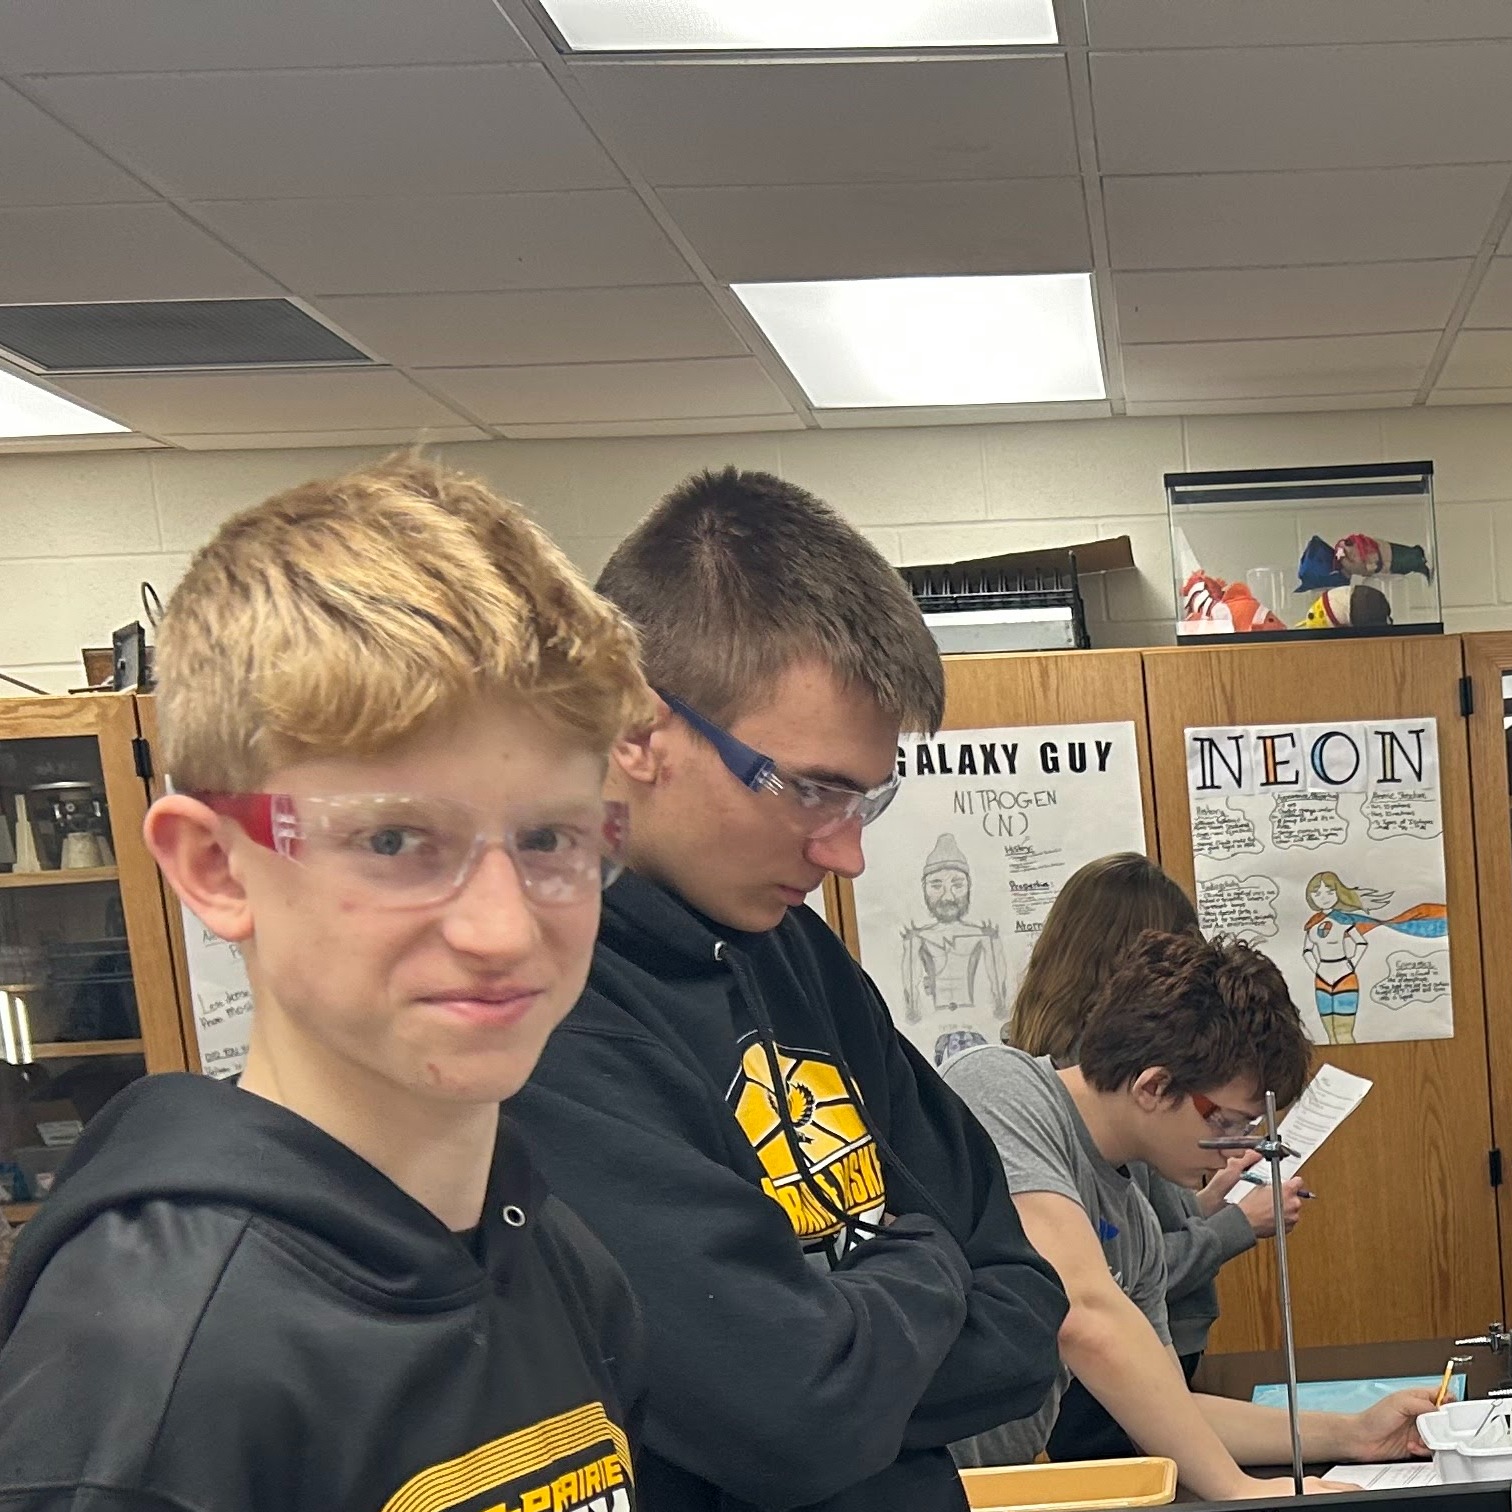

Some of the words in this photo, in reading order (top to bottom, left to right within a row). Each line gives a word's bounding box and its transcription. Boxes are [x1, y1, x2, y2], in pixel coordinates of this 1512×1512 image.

[1040, 741, 1113, 775] GUY
[1193, 729, 1425, 790] NEON
[954, 790, 1058, 815] NITROGEN
[982, 811, 1030, 838] (N)
